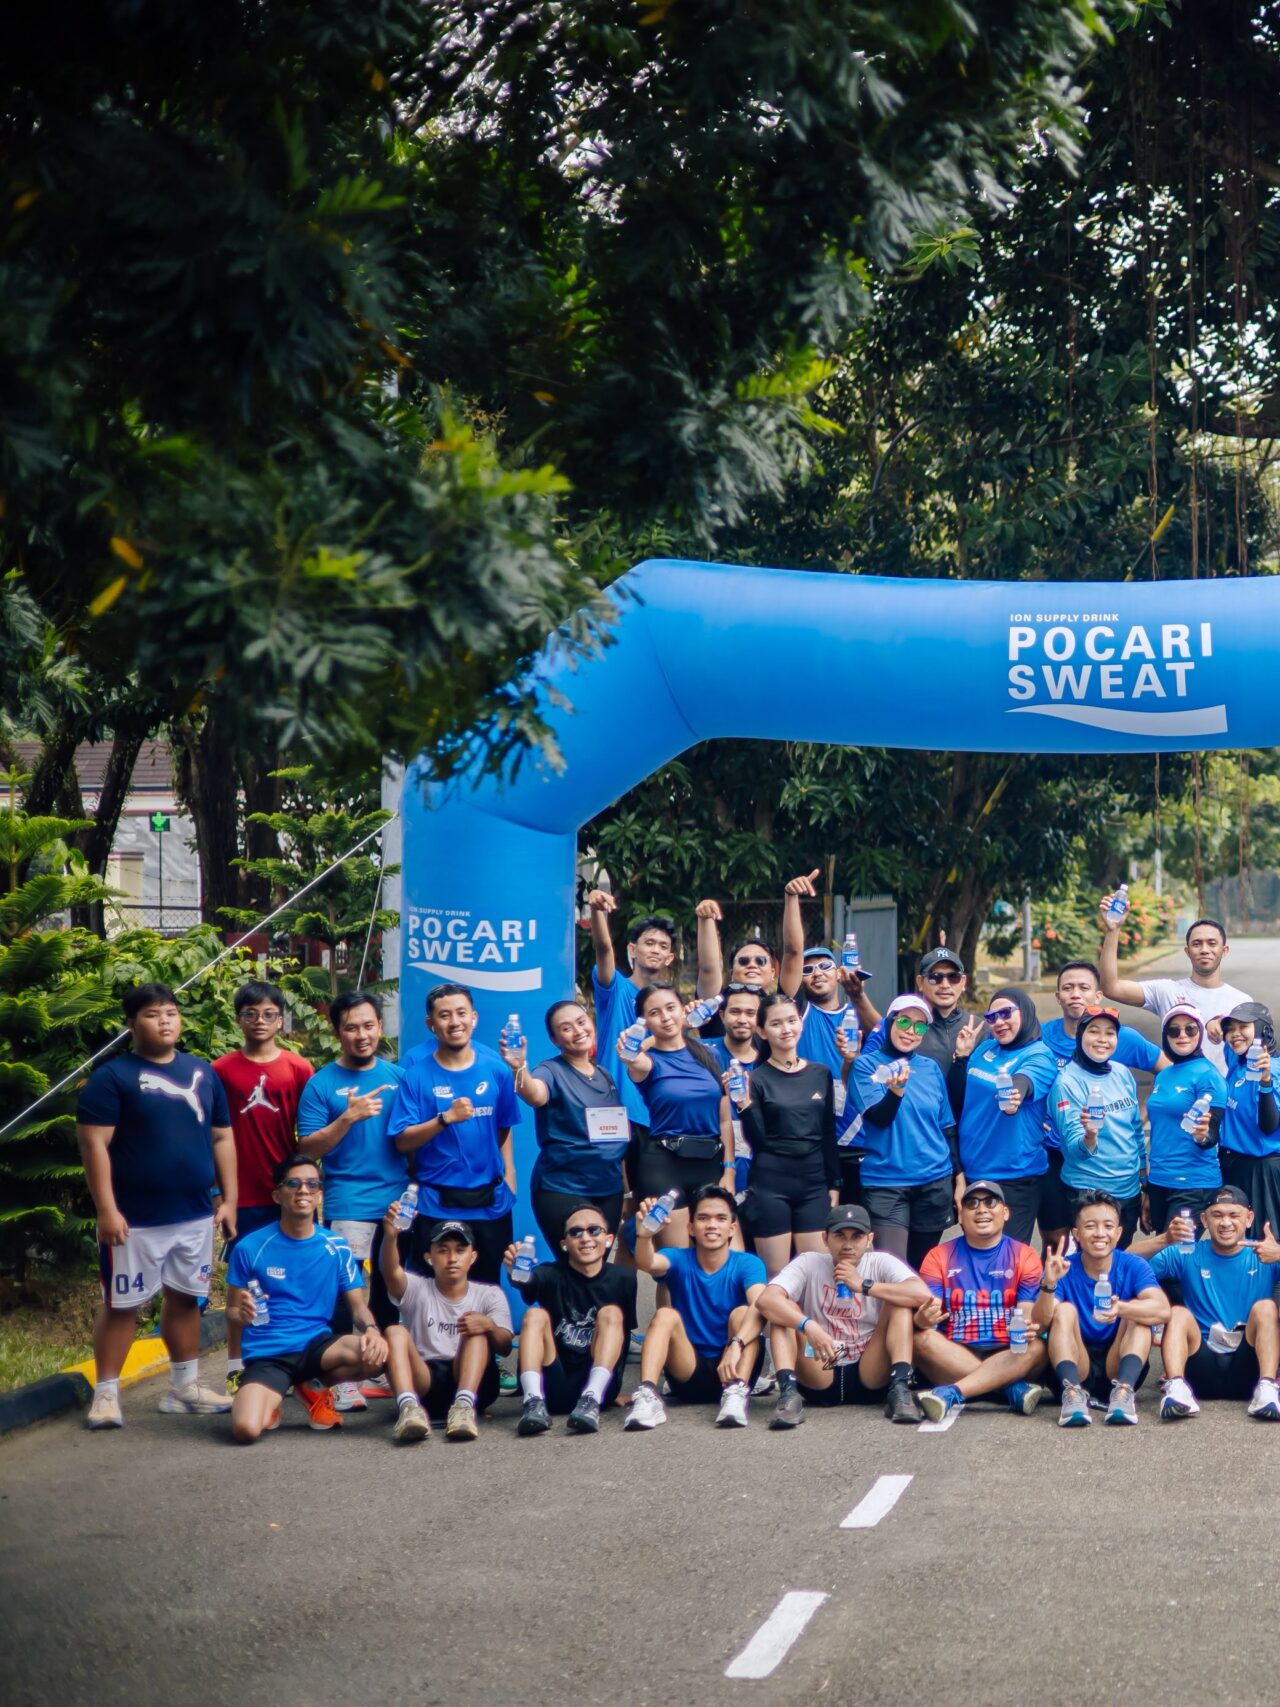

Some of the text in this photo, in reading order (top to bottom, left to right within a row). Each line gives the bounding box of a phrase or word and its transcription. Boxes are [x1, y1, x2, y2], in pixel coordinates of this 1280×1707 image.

[1010, 613, 1119, 623] ION SUPPLY DRINK
[1008, 622, 1213, 661] POCARI
[1008, 662, 1195, 700] SWEAT
[408, 915, 537, 941] POCARI
[408, 937, 525, 963] SWEAT
[116, 1272, 144, 1294] 04
